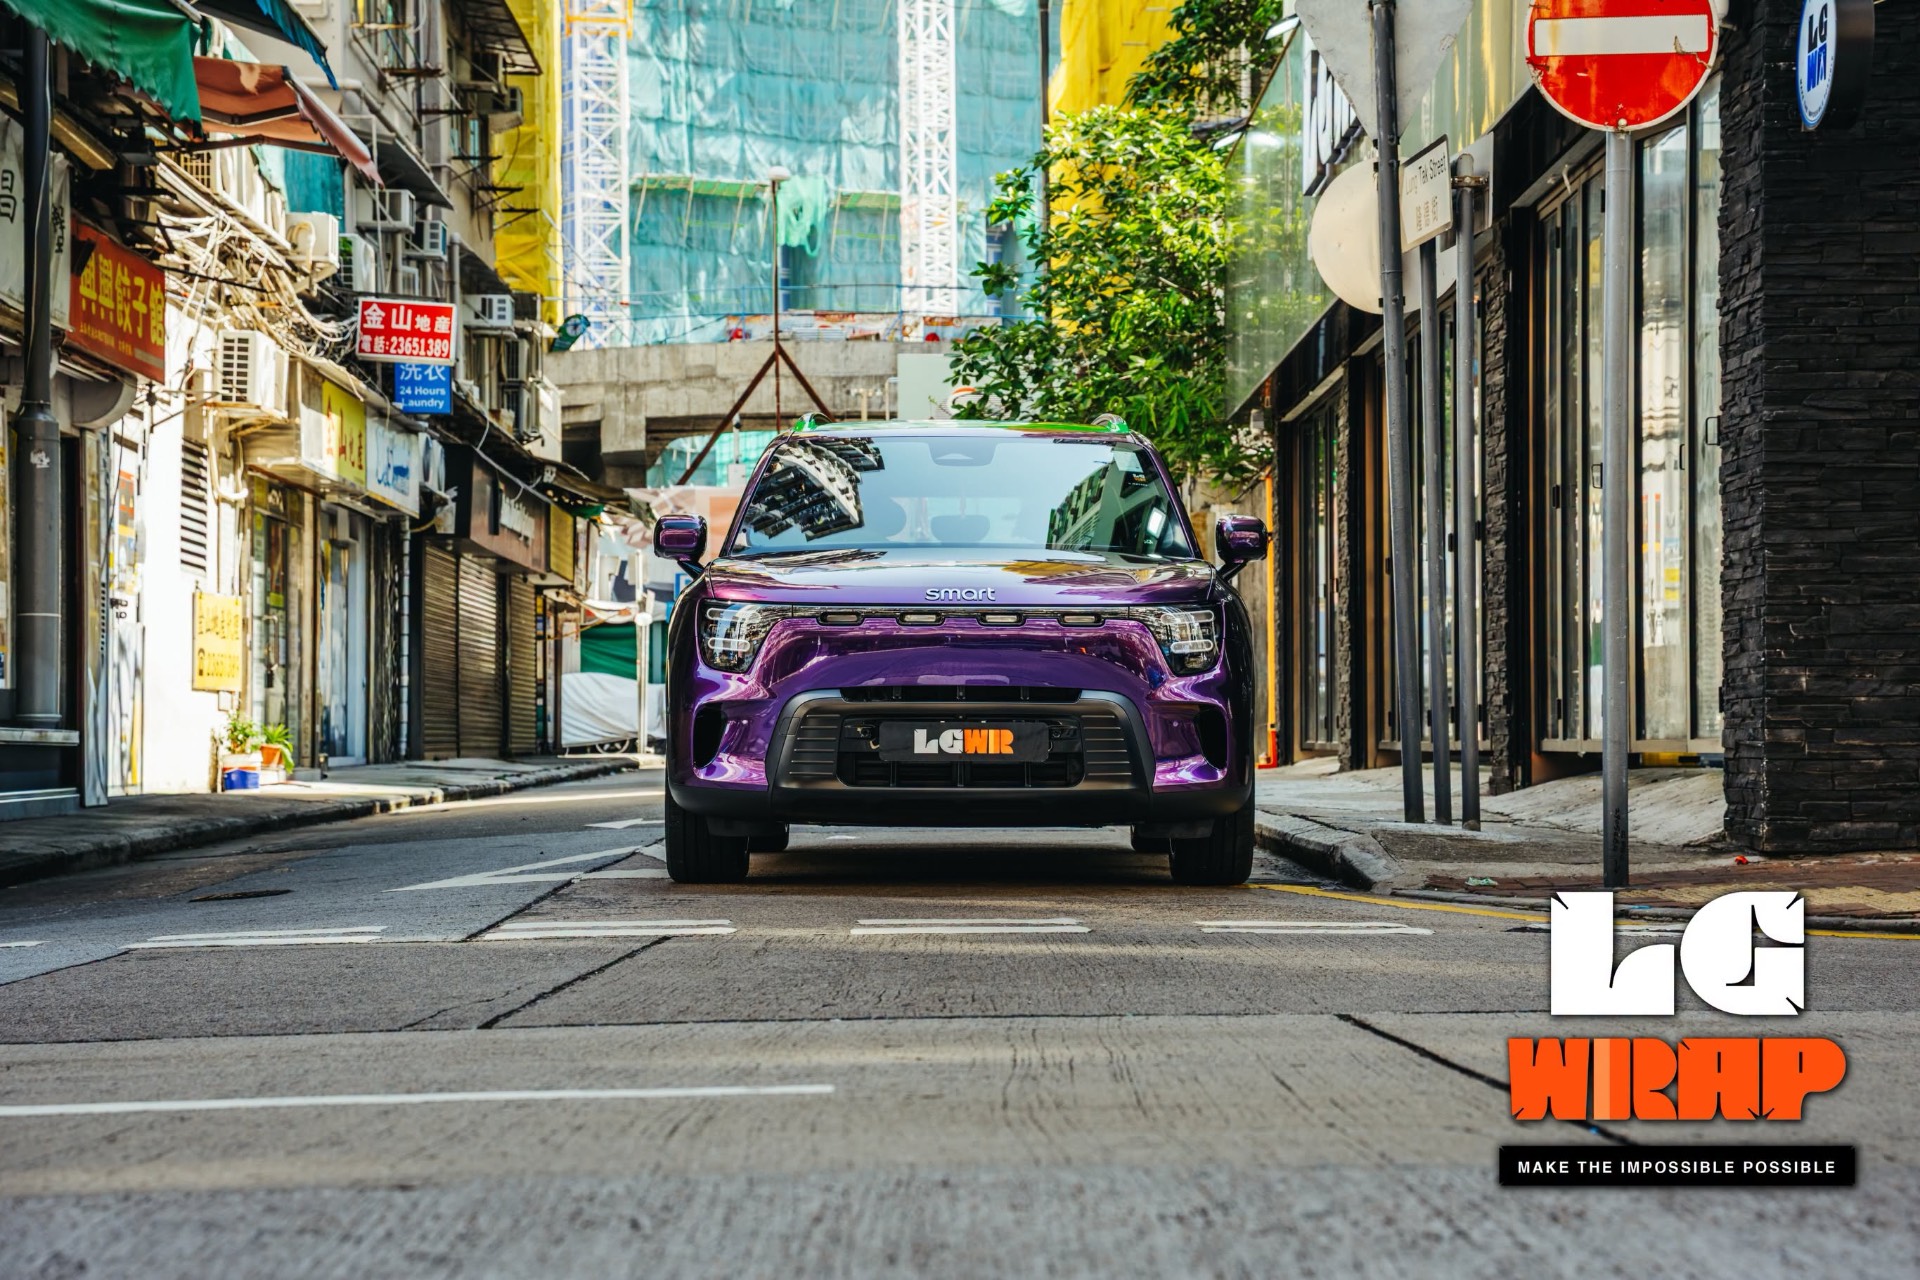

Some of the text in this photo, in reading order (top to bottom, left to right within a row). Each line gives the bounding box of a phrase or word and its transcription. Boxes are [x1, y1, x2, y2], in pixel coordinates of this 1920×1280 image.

[1807, 3, 1828, 53] LG
[1429, 152, 1447, 180] Street
[400, 363, 446, 381] 洗衣
[400, 386, 446, 395] 24 Hours
[402, 398, 444, 409] Laundry
[925, 587, 996, 601] smart
